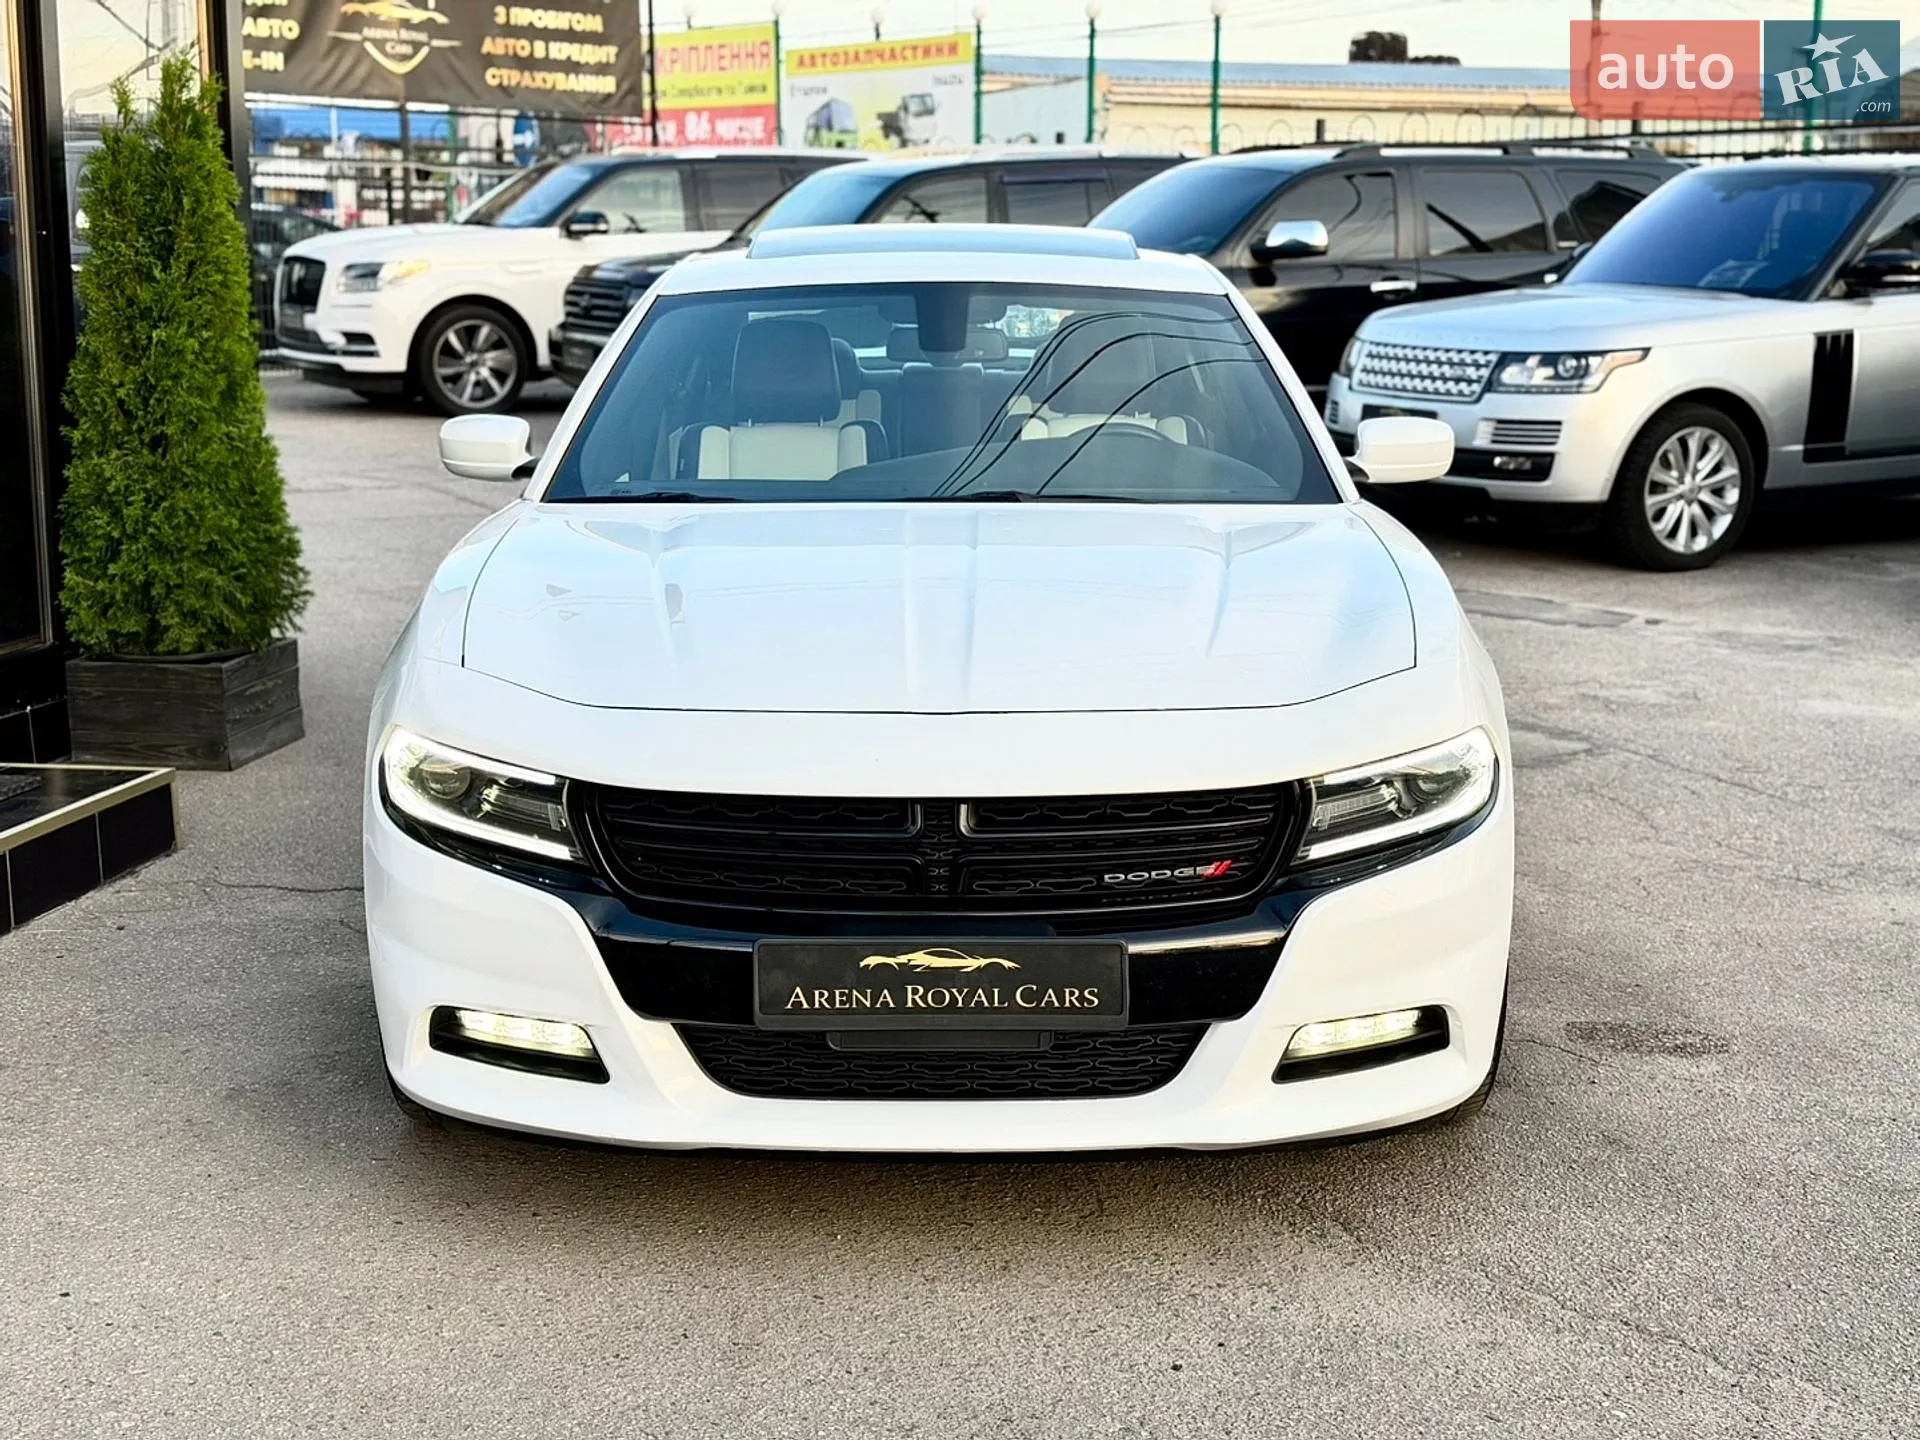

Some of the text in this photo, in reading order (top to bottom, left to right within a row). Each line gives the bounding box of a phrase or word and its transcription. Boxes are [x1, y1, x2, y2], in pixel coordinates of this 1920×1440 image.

[241, 16, 300, 40] АВТО
[481, 35, 531, 58] АВТО
[547, 41, 619, 65] КРЕДИТ
[796, 41, 959, 69] АВТОЗАПЧАСТИНИ
[484, 66, 617, 94] СТРАХУВАННЯ
[1104, 863, 1215, 883] DODGE
